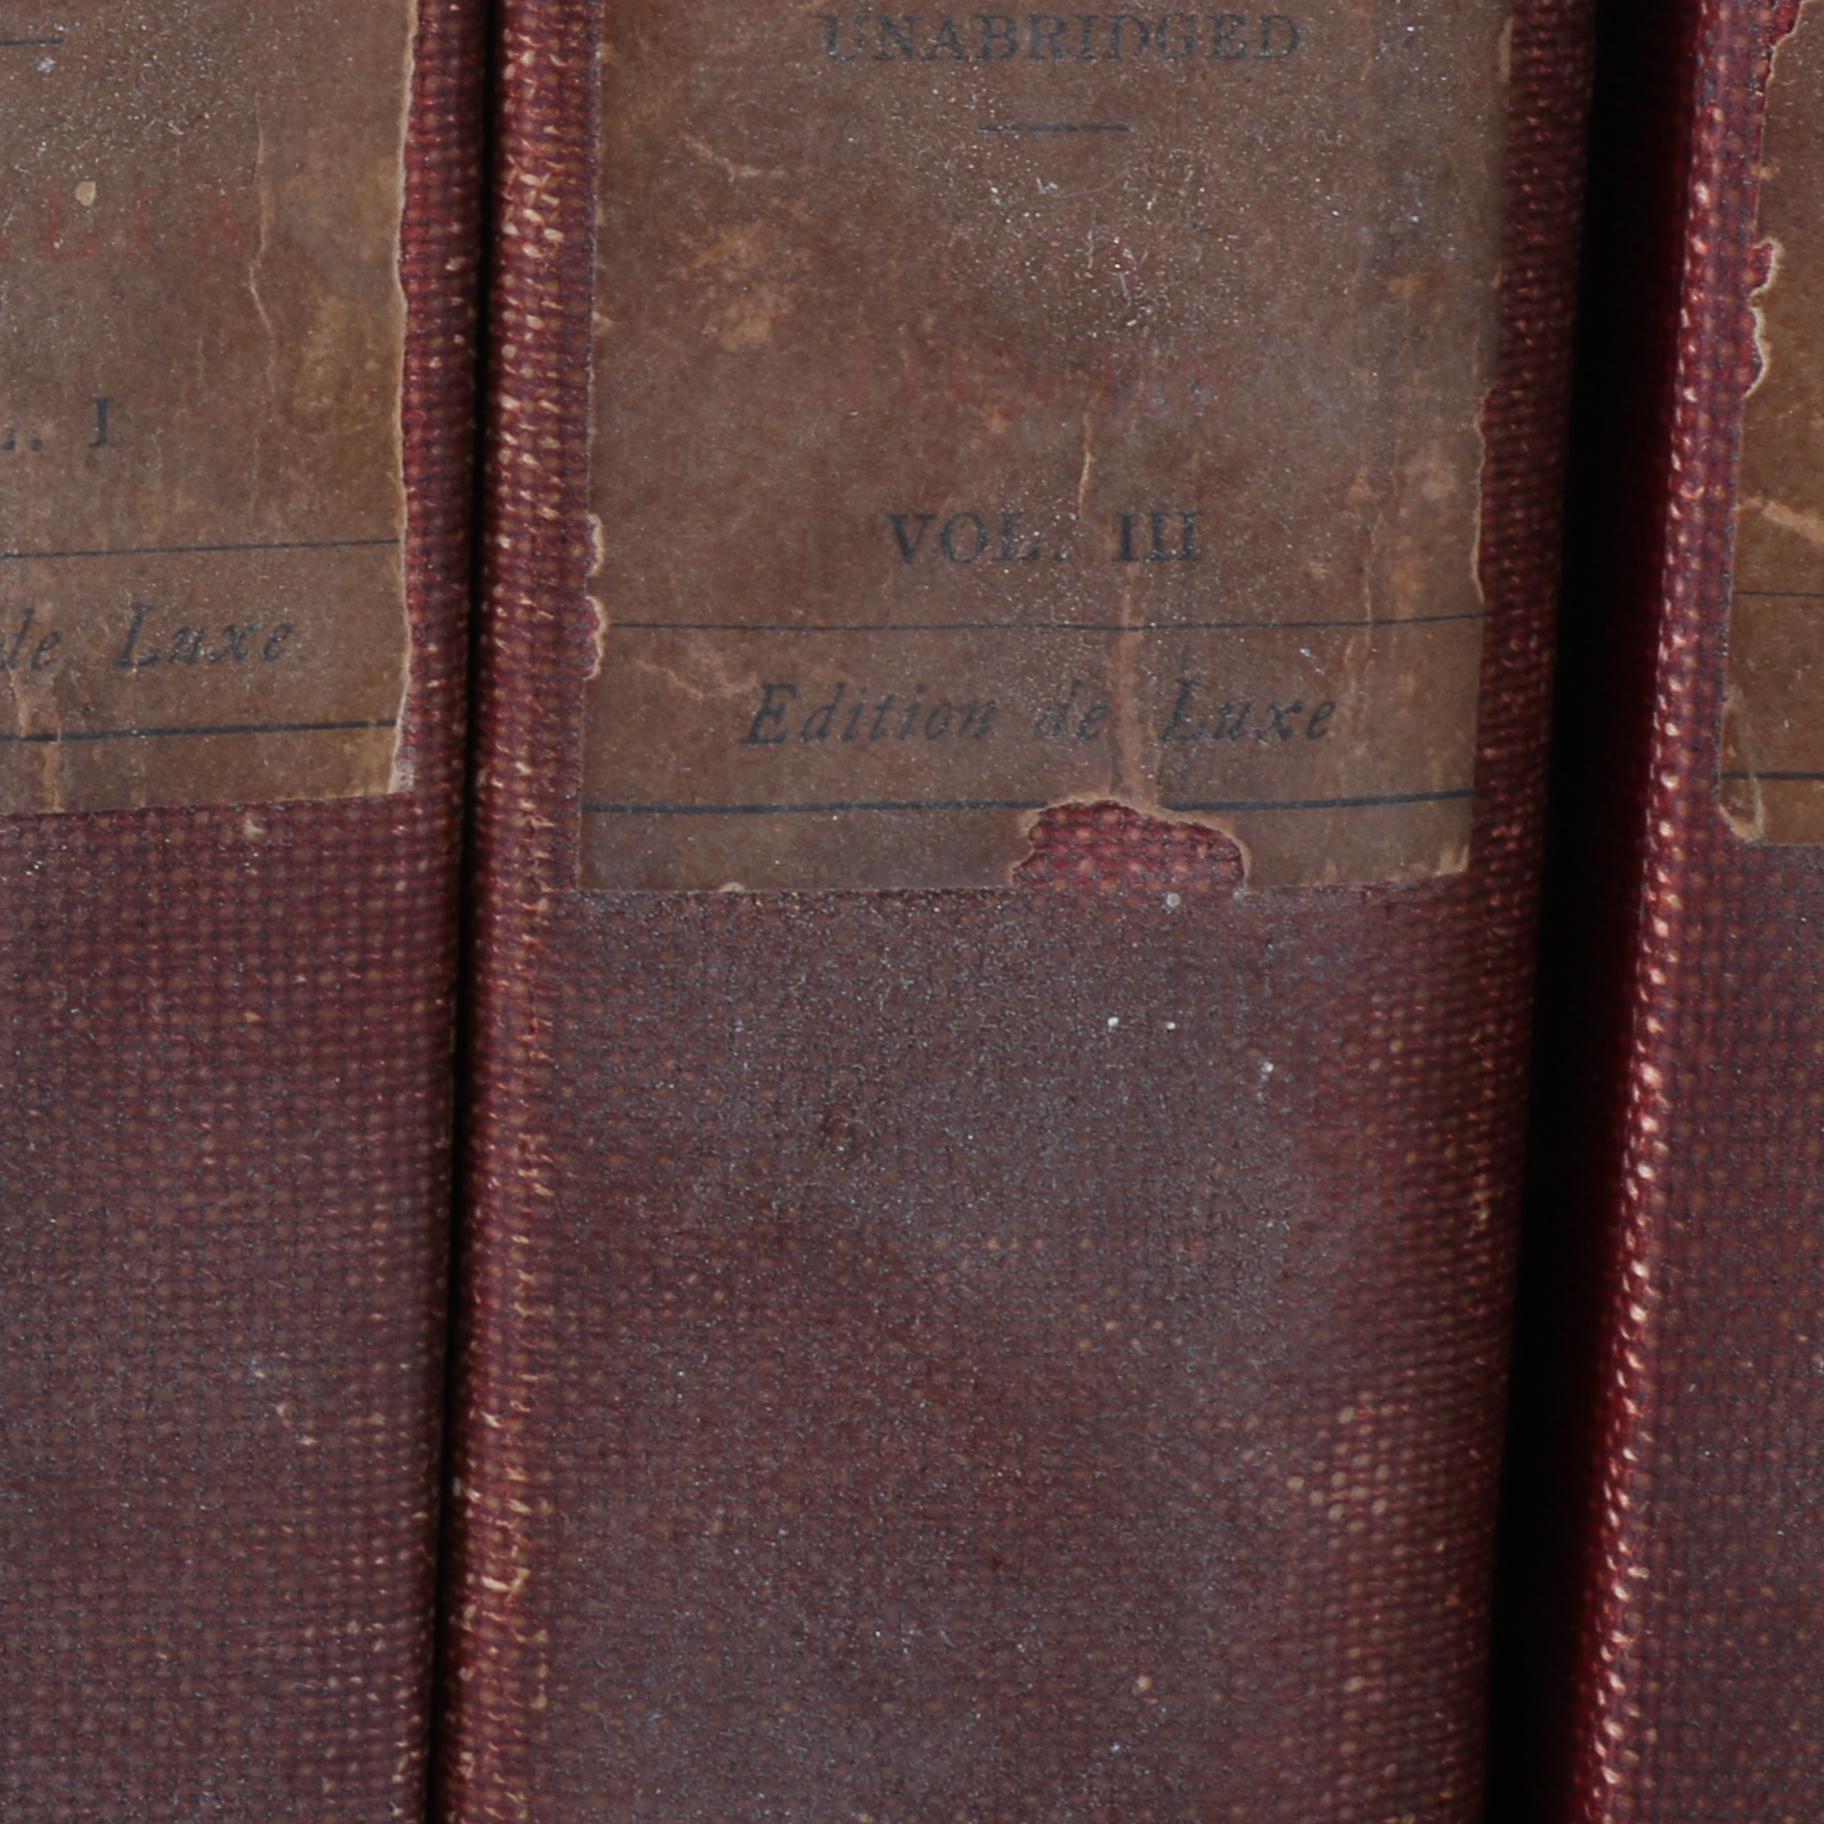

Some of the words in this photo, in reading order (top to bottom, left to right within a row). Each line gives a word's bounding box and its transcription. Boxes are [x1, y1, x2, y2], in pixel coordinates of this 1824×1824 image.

[821, 12, 1303, 62] UNABRIDGED
[88, 397, 118, 450] I
[886, 511, 1071, 565] VOL.
[1111, 510, 1205, 563] III
[113, 604, 294, 669] Luxe
[740, 681, 998, 745] Edition
[1034, 681, 1110, 743] de
[1161, 677, 1338, 744] Luxe
